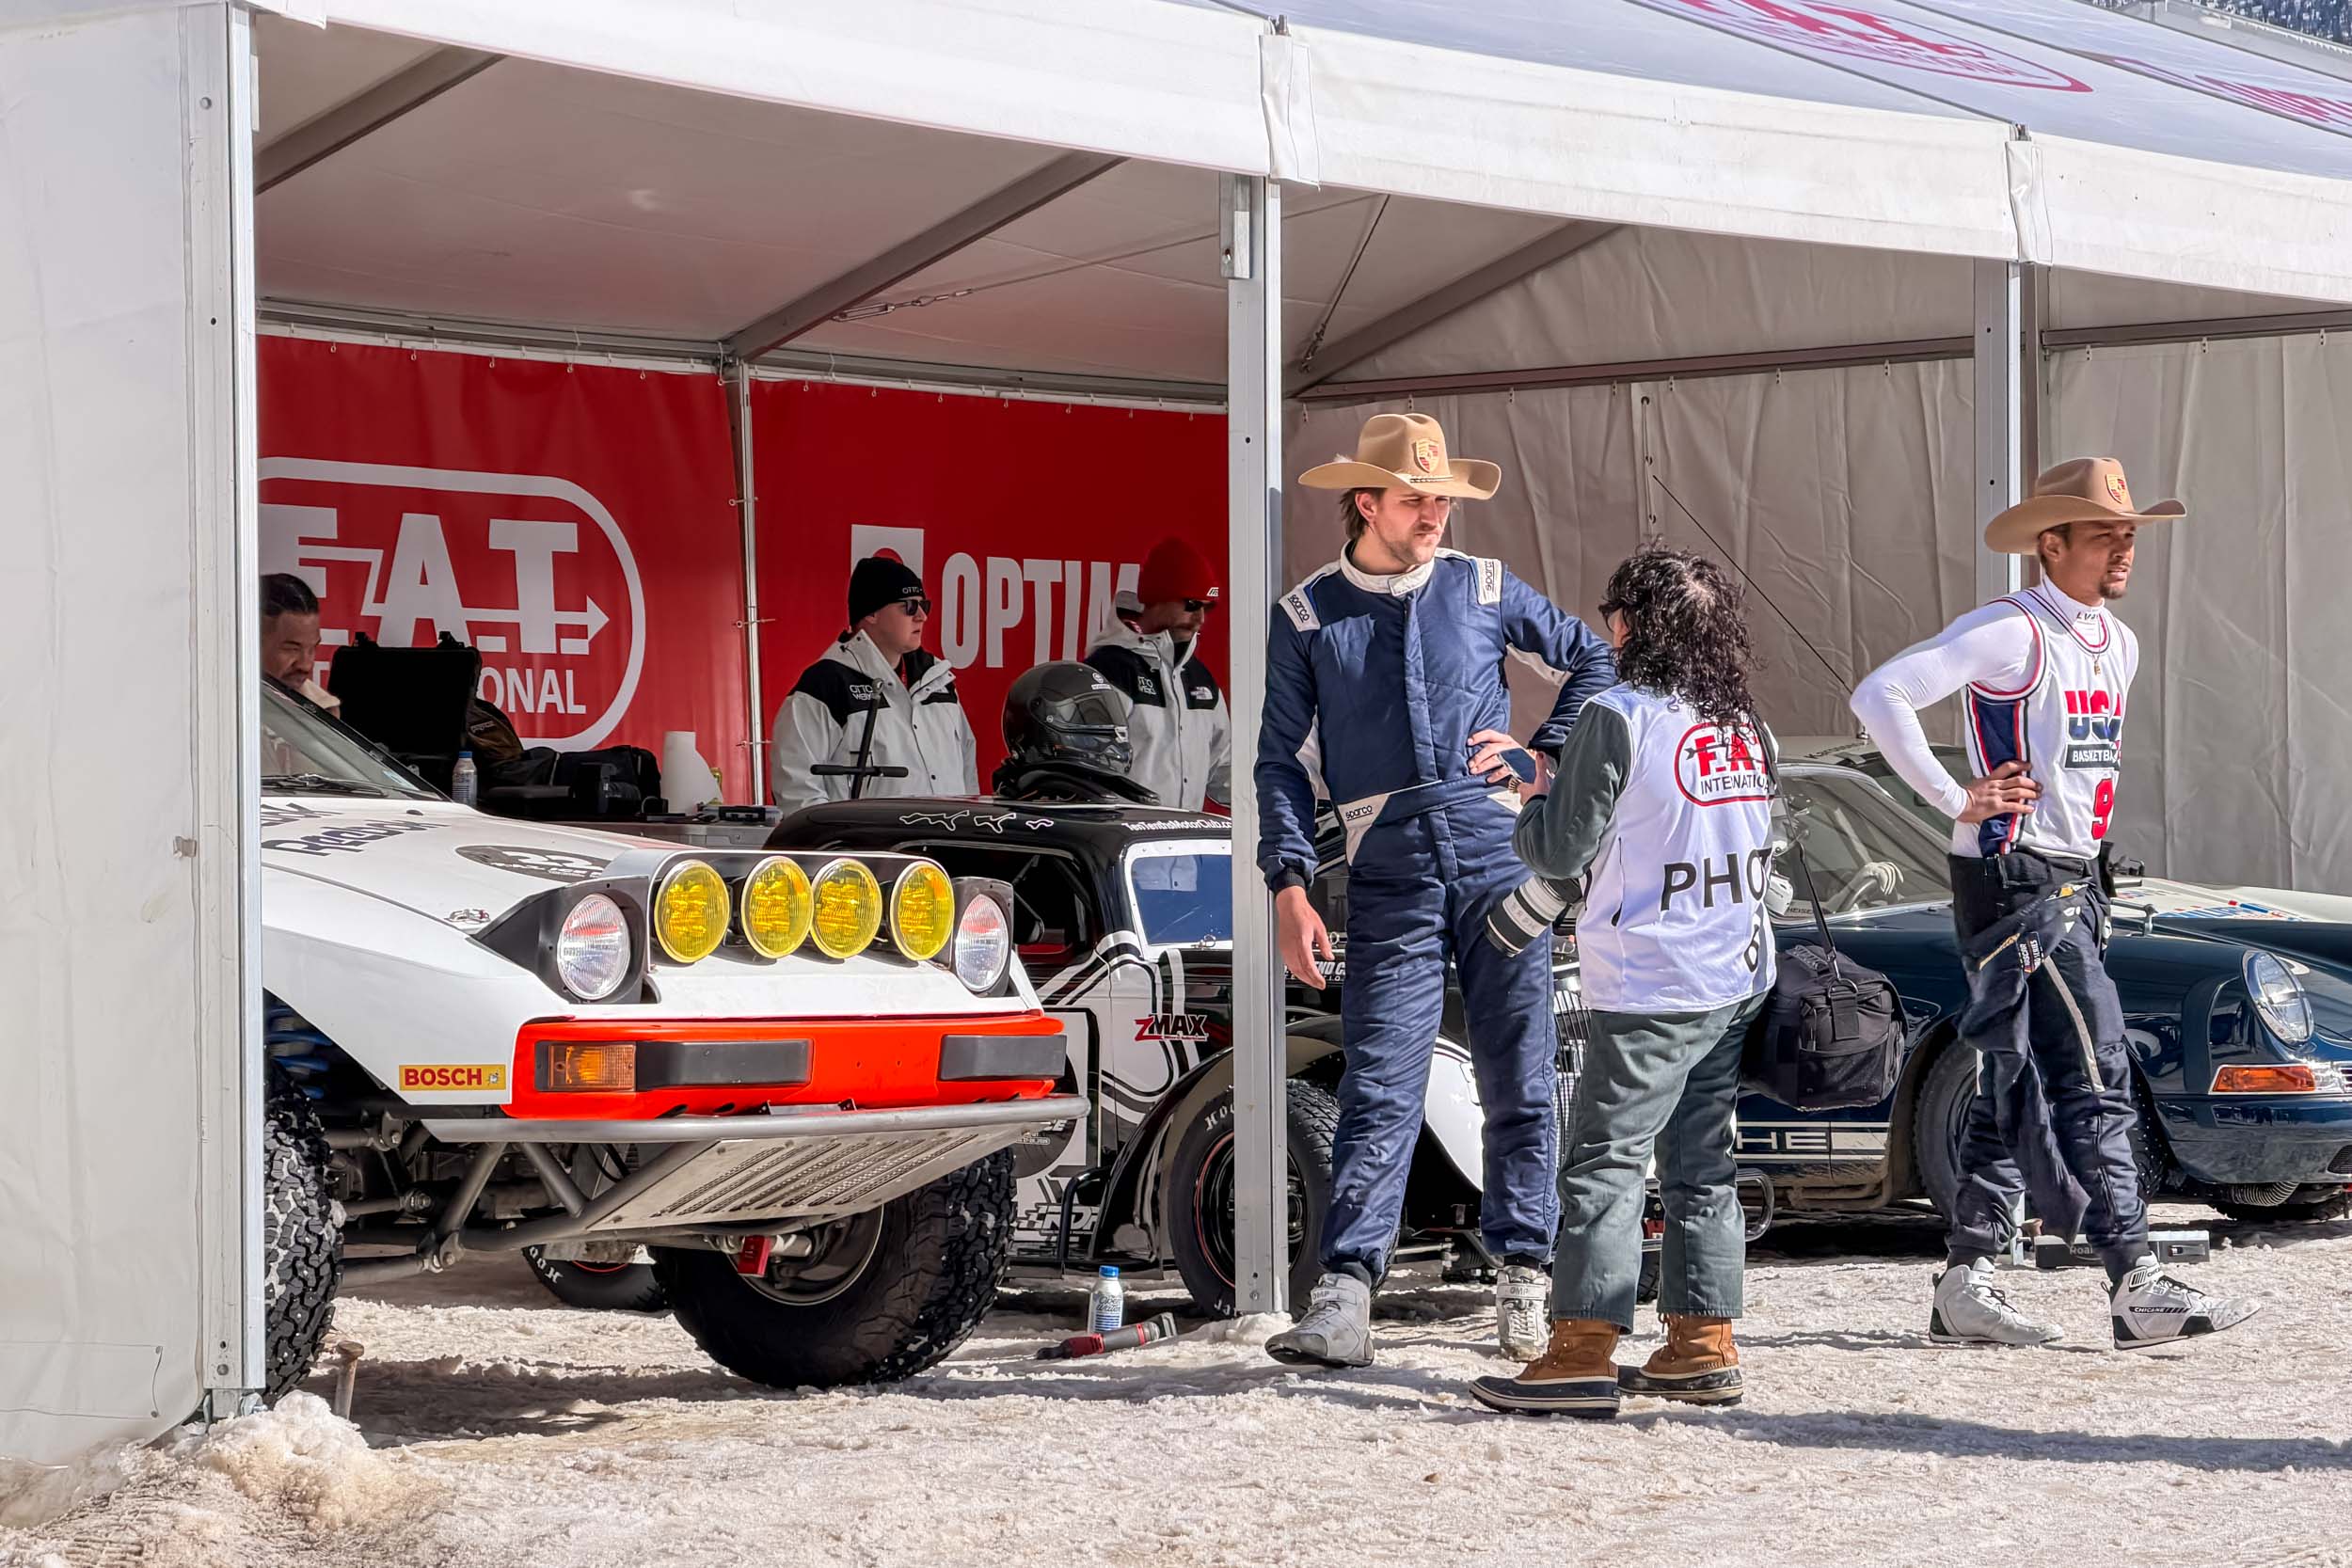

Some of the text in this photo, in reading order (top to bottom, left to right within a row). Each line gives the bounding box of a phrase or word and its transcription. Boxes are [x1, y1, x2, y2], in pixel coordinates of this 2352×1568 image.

[1290, 594, 1311, 622] sparco
[1345, 804, 1373, 819] sparco
[2090, 778, 2114, 840] 9
[404, 1068, 483, 1086] BOSCH
[1510, 1286, 1529, 1295] OMP
